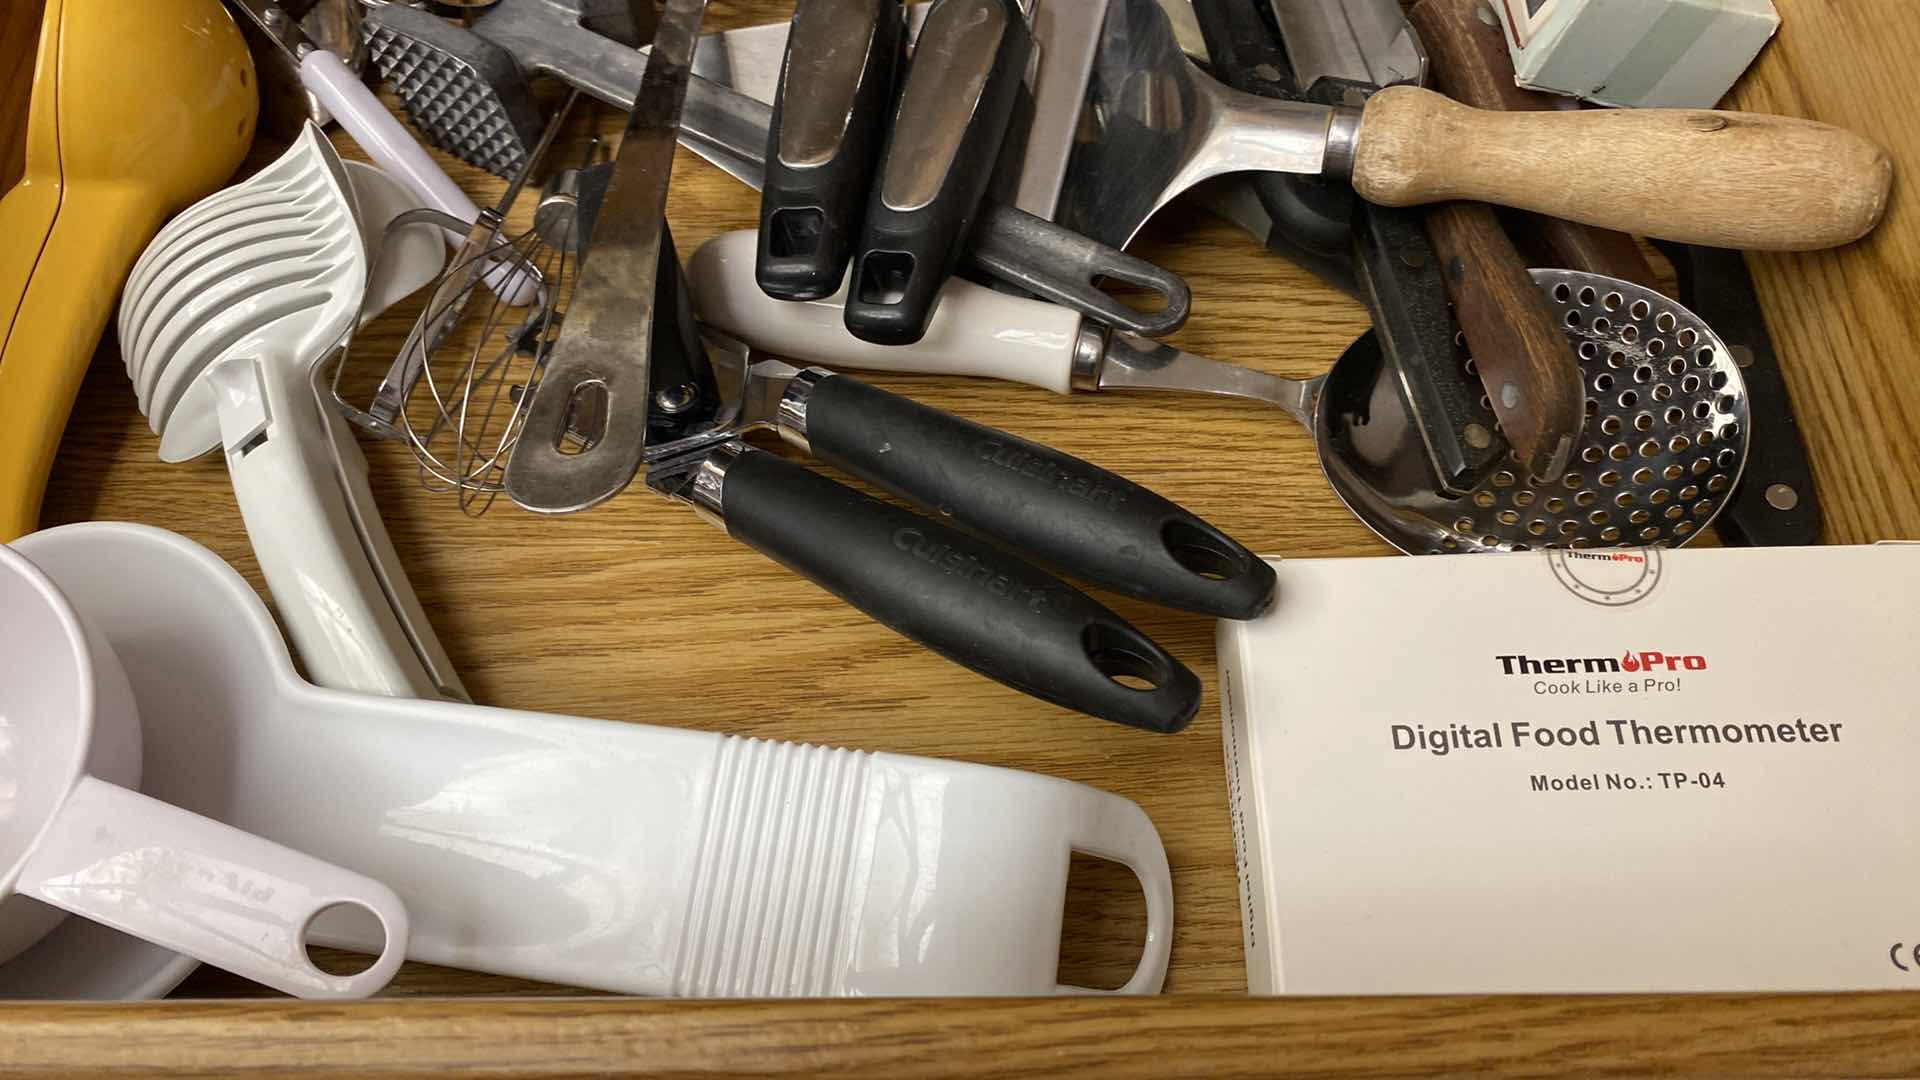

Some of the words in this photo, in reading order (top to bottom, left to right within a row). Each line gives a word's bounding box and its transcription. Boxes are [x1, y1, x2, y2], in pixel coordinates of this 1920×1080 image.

[1534, 680, 1580, 695] Cook
[1585, 679, 1622, 694] Like
[1628, 680, 1638, 692] a
[1644, 677, 1681, 692] Pro!
[1391, 722, 1503, 756] Digital
[1511, 720, 1600, 747] Food
[1606, 718, 1843, 744] Thermometer
[1530, 774, 1600, 791] Model
[1605, 773, 1652, 790] No.:
[1658, 772, 1726, 789] TP-04
